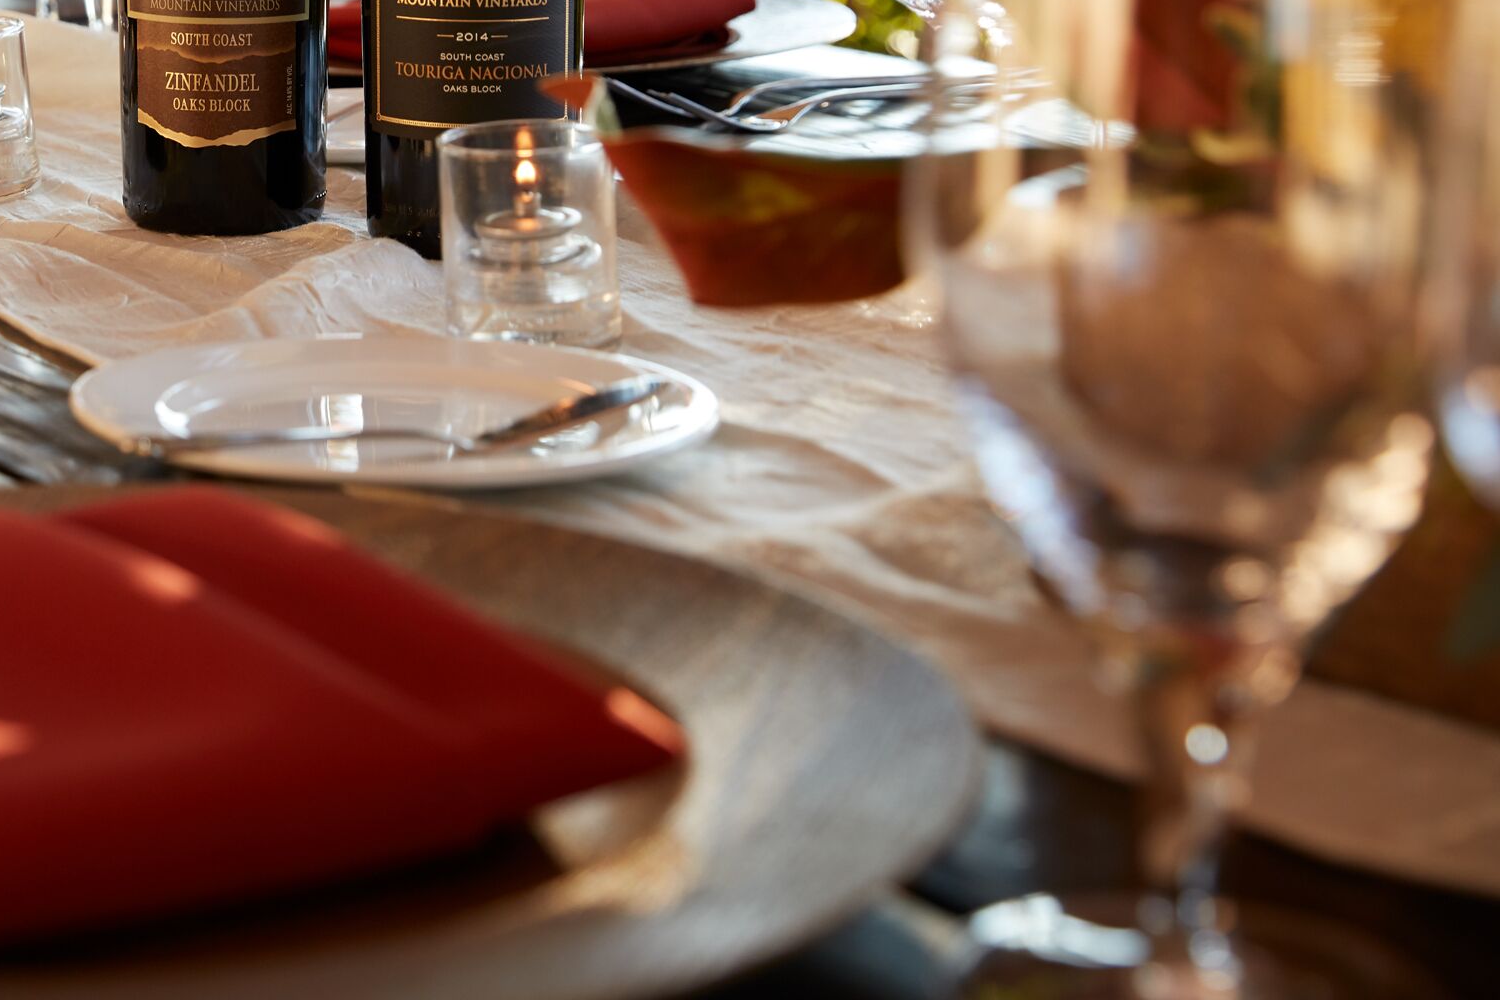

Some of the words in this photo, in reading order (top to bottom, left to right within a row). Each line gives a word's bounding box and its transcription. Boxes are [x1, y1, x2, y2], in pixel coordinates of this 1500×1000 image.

[170, 31, 209, 47] SOUTH
[212, 33, 253, 47] COAST
[456, 32, 489, 42] 2014
[440, 52, 472, 62] SOUTH
[474, 53, 505, 62] COAST
[395, 61, 464, 80] TOURIGA
[469, 63, 550, 80] NACIONAL
[165, 71, 260, 92] ZINFANDEL
[443, 84, 468, 93] OAKS
[471, 85, 502, 93] BLOCK
[173, 97, 206, 112] OAKS
[209, 98, 251, 112] BLOCK
